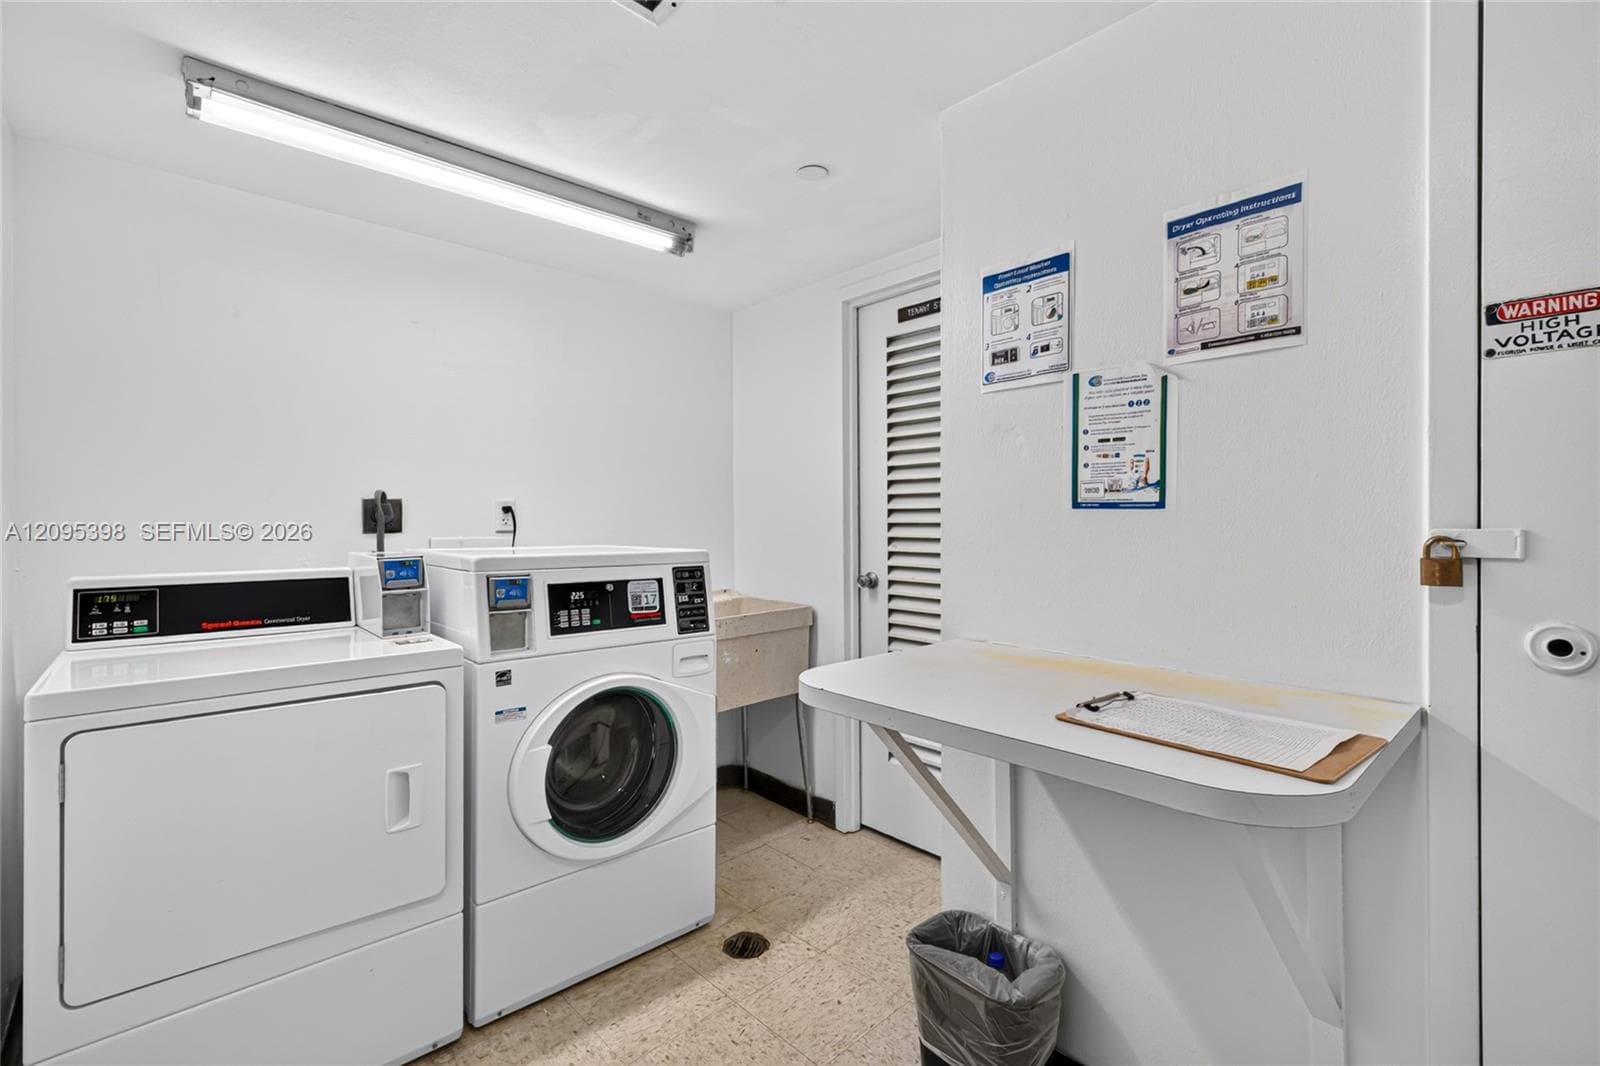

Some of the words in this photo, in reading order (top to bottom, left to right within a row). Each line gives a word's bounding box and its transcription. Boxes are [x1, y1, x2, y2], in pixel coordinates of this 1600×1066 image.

[1172, 222, 1195, 233] Dryer
[1195, 208, 1240, 226] Operating
[907, 303, 930, 317] TENANT
[1501, 292, 1599, 319] WARNING
[1521, 314, 1580, 333] HIGH
[1497, 348, 1527, 356] FLORIDA
[1529, 344, 1554, 352] POWER
[644, 594, 657, 605] 17
[201, 620, 232, 630] Speed
[263, 617, 296, 625] Commercial
[296, 615, 311, 623] Dryer
